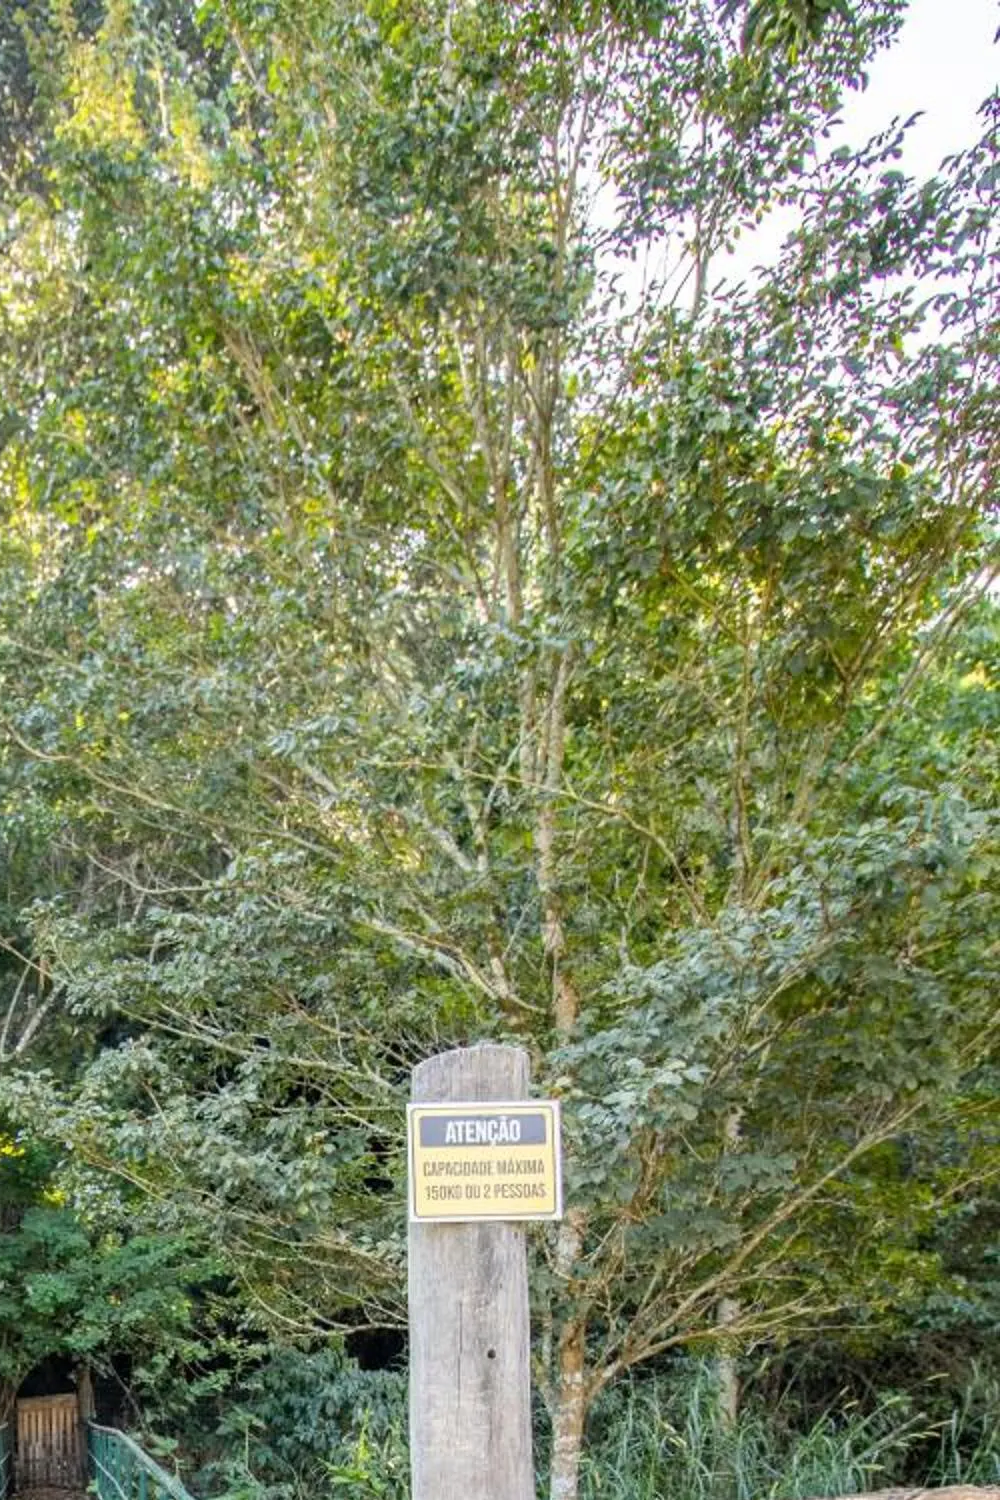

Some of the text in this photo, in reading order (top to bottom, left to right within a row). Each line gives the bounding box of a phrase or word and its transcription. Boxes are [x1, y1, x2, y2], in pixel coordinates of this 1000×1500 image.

[445, 1116, 521, 1145] ATENÇÃO
[423, 1158, 545, 1177] CAPACIDADE MÁXIMA
[466, 1184, 481, 1200] OU
[483, 1184, 492, 1199] 2
[494, 1183, 547, 1199] PESSOAS
